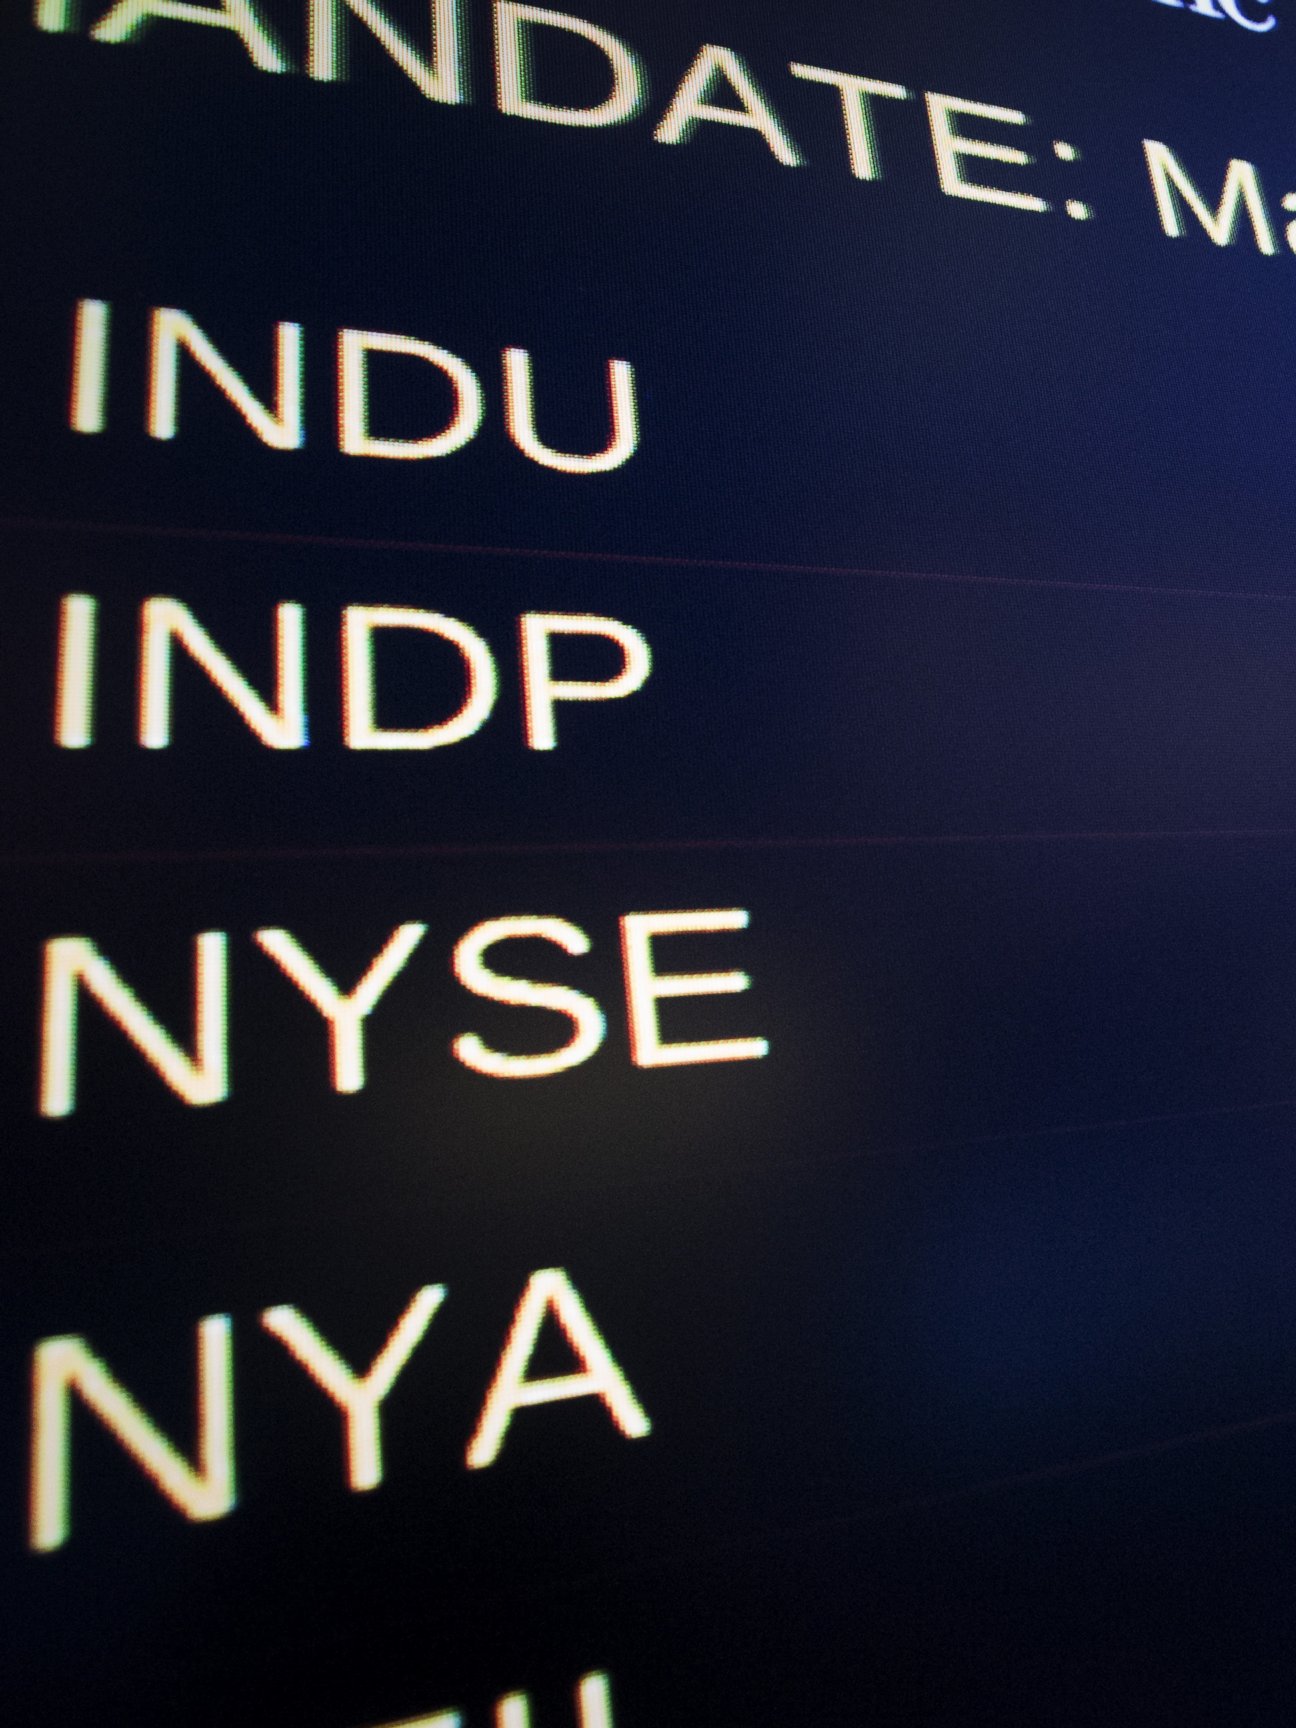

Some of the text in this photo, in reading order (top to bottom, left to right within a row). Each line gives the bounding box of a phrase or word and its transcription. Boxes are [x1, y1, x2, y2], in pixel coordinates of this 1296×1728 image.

[71, 298, 640, 474] INDU
[55, 592, 653, 751] INDP
[38, 907, 771, 1119] NYSE
[30, 1266, 652, 1553] NYA
